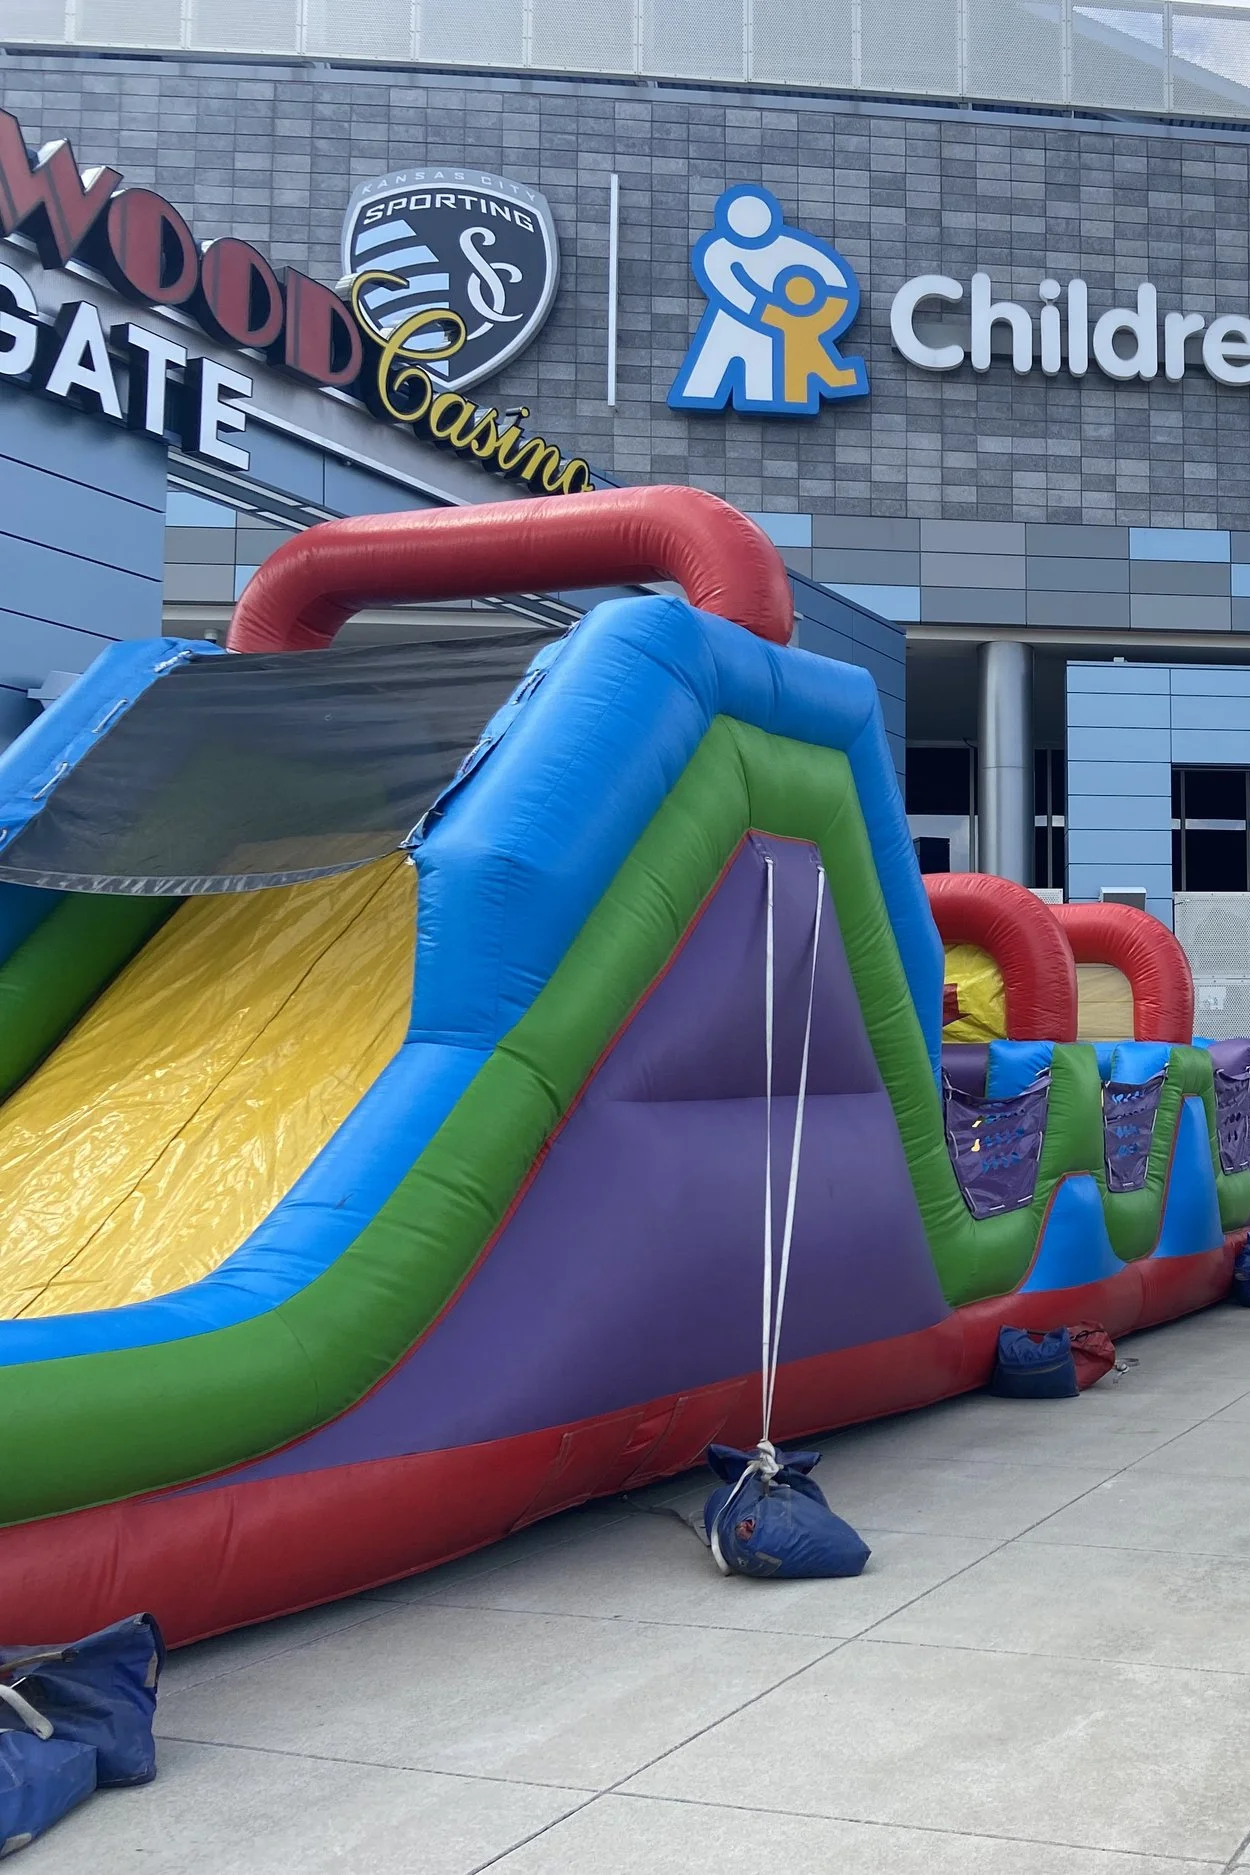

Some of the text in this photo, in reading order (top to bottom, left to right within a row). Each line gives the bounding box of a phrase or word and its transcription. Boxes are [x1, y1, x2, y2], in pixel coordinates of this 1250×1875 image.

[361, 171, 536, 202] KANSAS CITY
[363, 193, 535, 233] SPORTING
[352, 271, 593, 495] Casino
